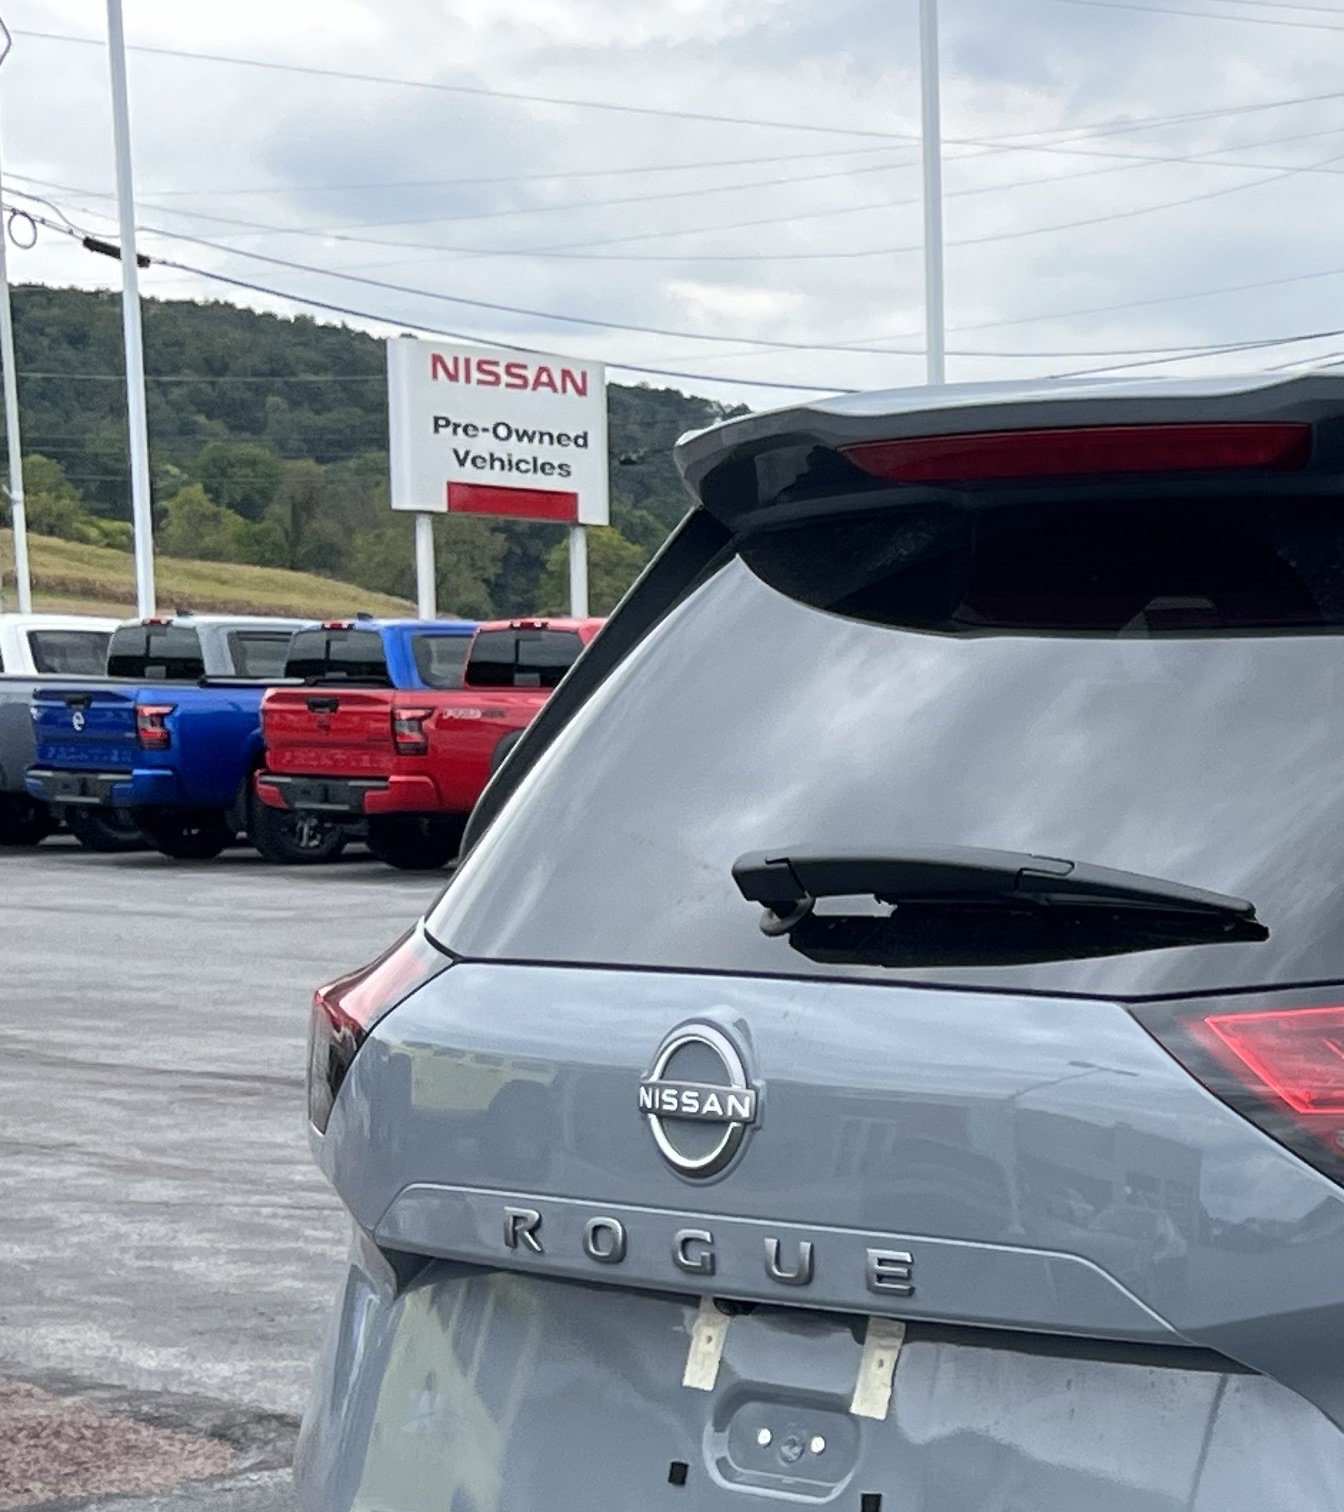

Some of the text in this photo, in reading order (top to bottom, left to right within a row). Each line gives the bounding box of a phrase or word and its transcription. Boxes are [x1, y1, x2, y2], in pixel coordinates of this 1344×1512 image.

[431, 353, 588, 397] NISSAN
[433, 416, 589, 450] Pre-Owned
[453, 448, 572, 478] Vehicles
[638, 1085, 752, 1119] NISSAN
[503, 1205, 916, 1297] ROGUE
